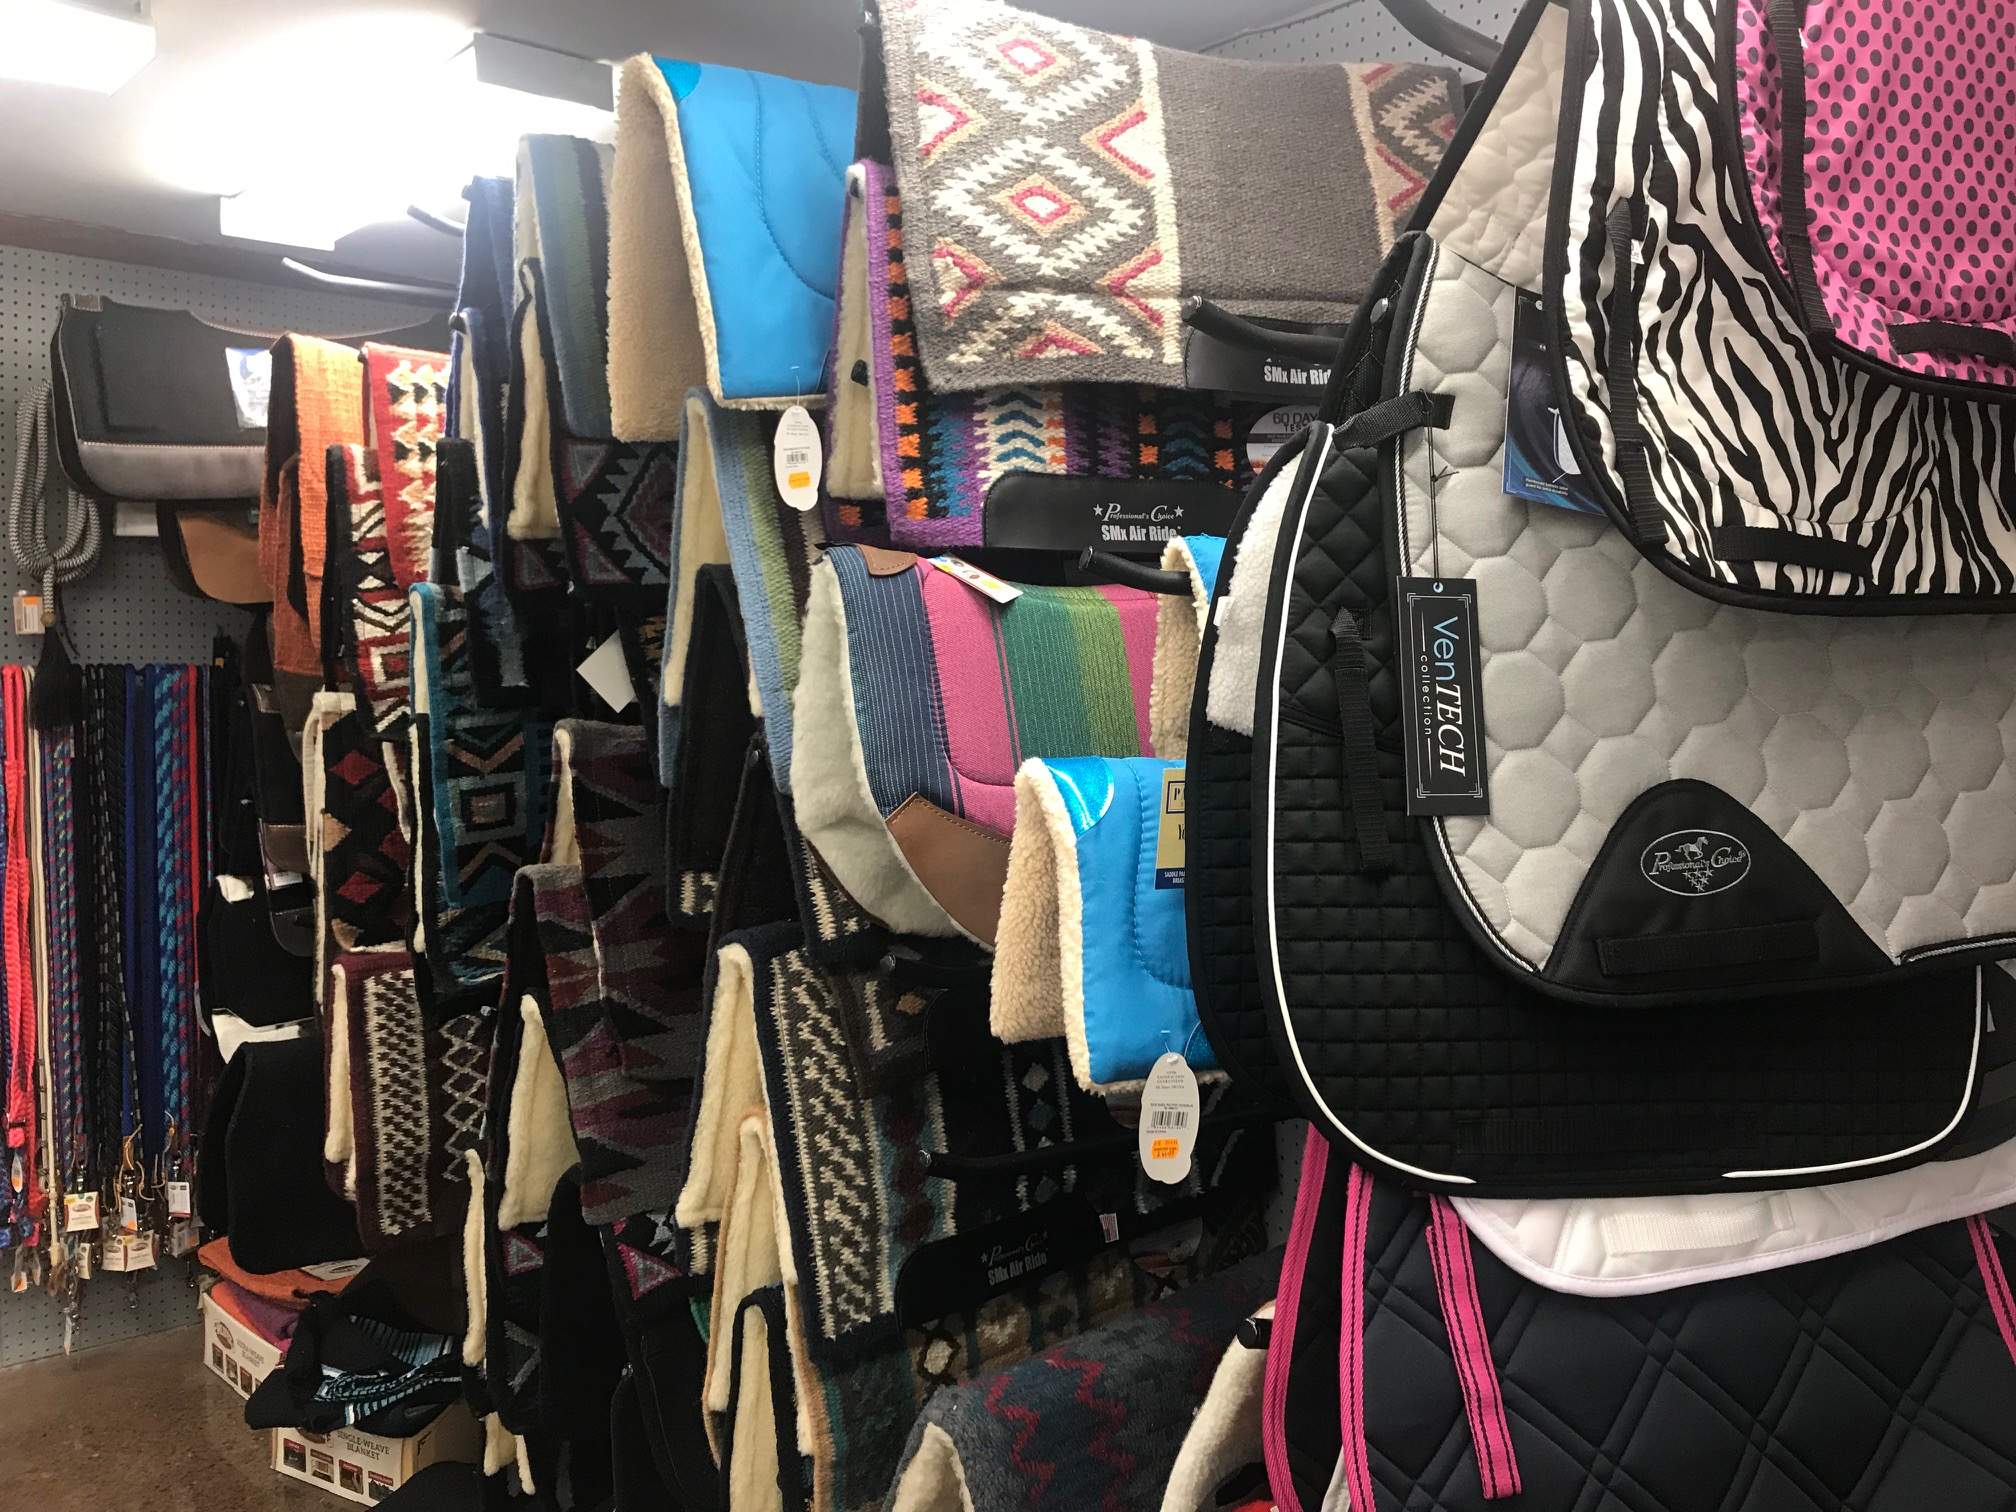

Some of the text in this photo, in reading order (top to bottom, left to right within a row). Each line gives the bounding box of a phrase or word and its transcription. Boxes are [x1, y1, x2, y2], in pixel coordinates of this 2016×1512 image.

[1290, 368, 1308, 385] Air
[1309, 368, 1332, 386] Rid
[1101, 502, 1175, 522] Professional's Choice
[1101, 524, 1128, 541] SMx
[1129, 525, 1147, 541] Air
[1420, 654, 1432, 735] collection
[1433, 616, 1466, 777] VenTECH
